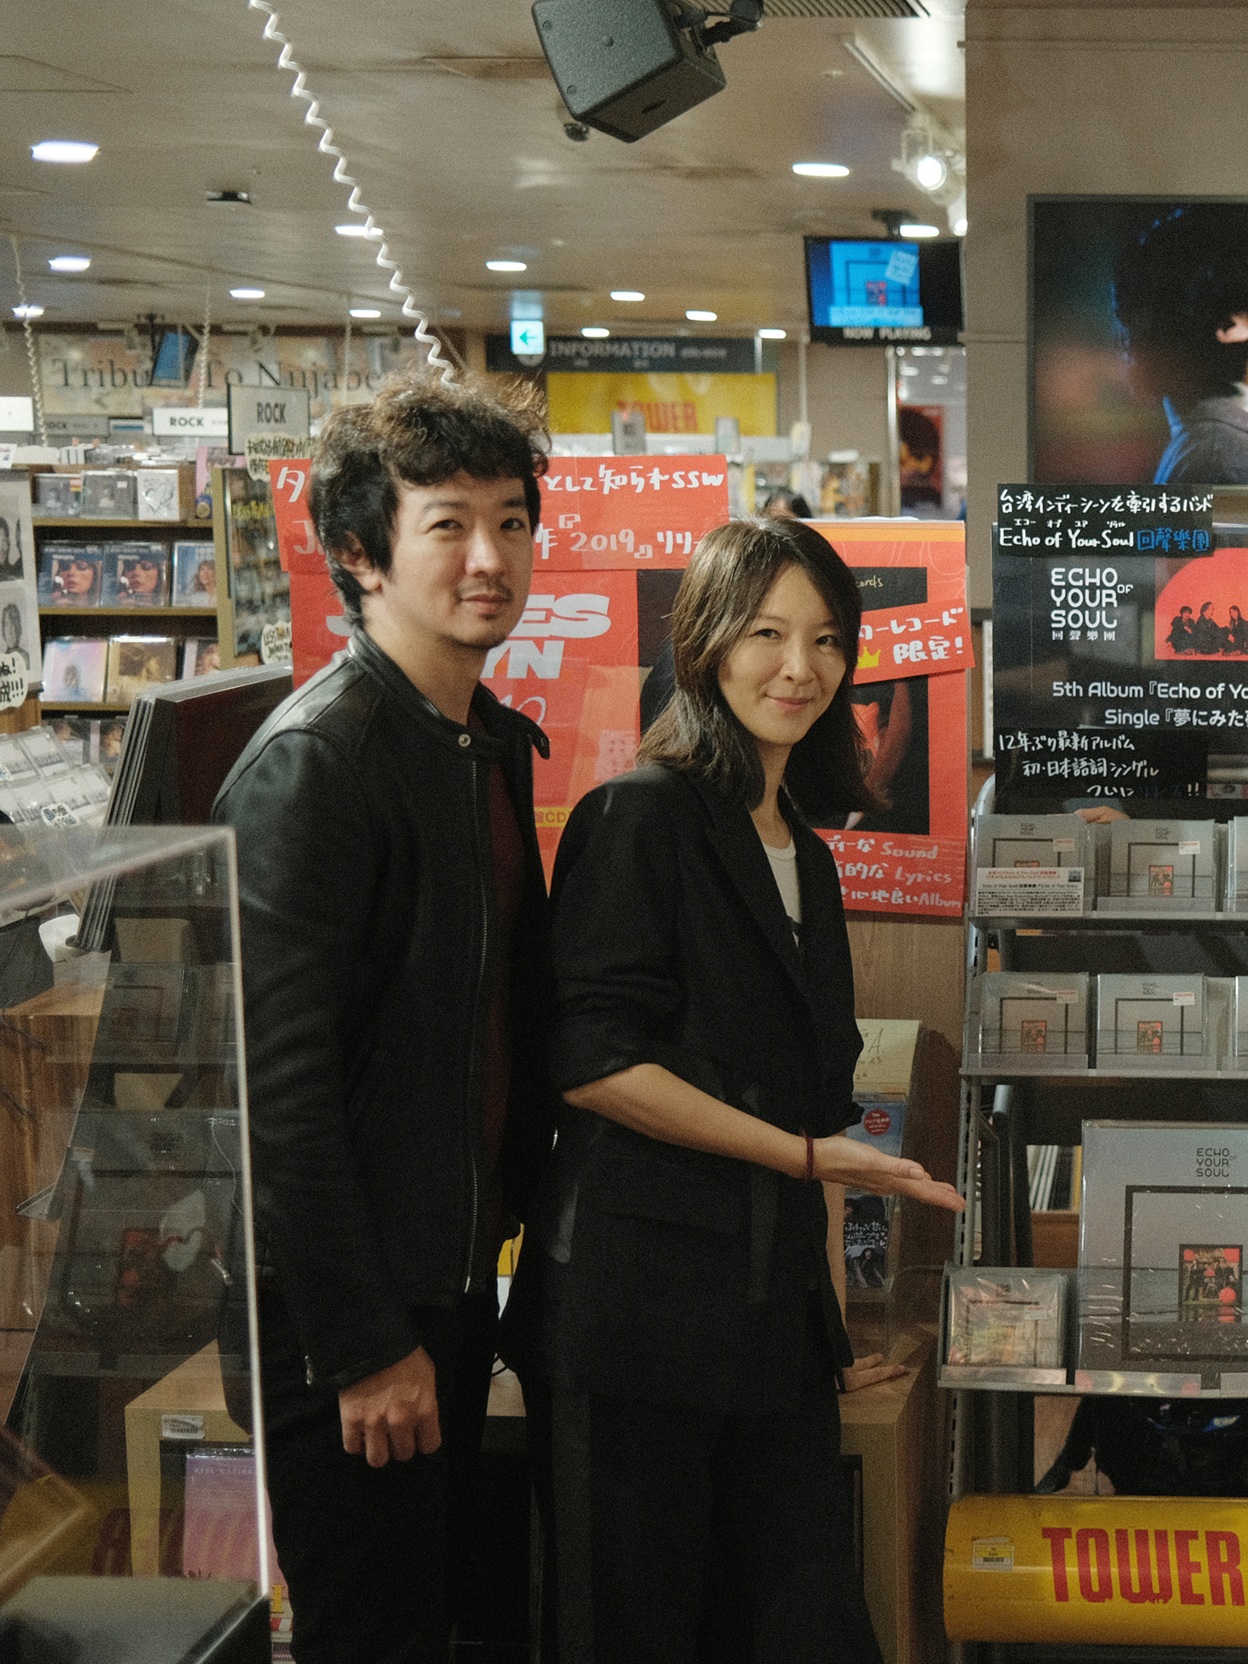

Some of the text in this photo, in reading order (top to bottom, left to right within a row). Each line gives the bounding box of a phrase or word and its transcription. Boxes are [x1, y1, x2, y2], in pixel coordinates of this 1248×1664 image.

[169, 416, 204, 428] ROCK
[257, 402, 287, 424] ROCK
[999, 527, 1041, 547] Echo
[1045, 529, 1063, 548] of
[1067, 528, 1100, 549] Your
[1101, 529, 1134, 548] Soul
[1051, 568, 1134, 594] ECHO OF
[1051, 588, 1118, 608] YOUR
[859, 606, 964, 641] ワーレコード
[1051, 609, 1118, 628] SOUL
[1052, 681, 1084, 698] 5th
[1087, 681, 1144, 699] Album
[1205, 682, 1224, 700] of
[1105, 709, 1160, 728] Single
[880, 841, 939, 860] Sound
[895, 866, 953, 886] Lyrics
[1196, 1147, 1230, 1157] ECHO
[1196, 1158, 1230, 1167] YOUR
[1196, 1168, 1230, 1177] SOUL
[1041, 1526, 1246, 1607] TOWER
